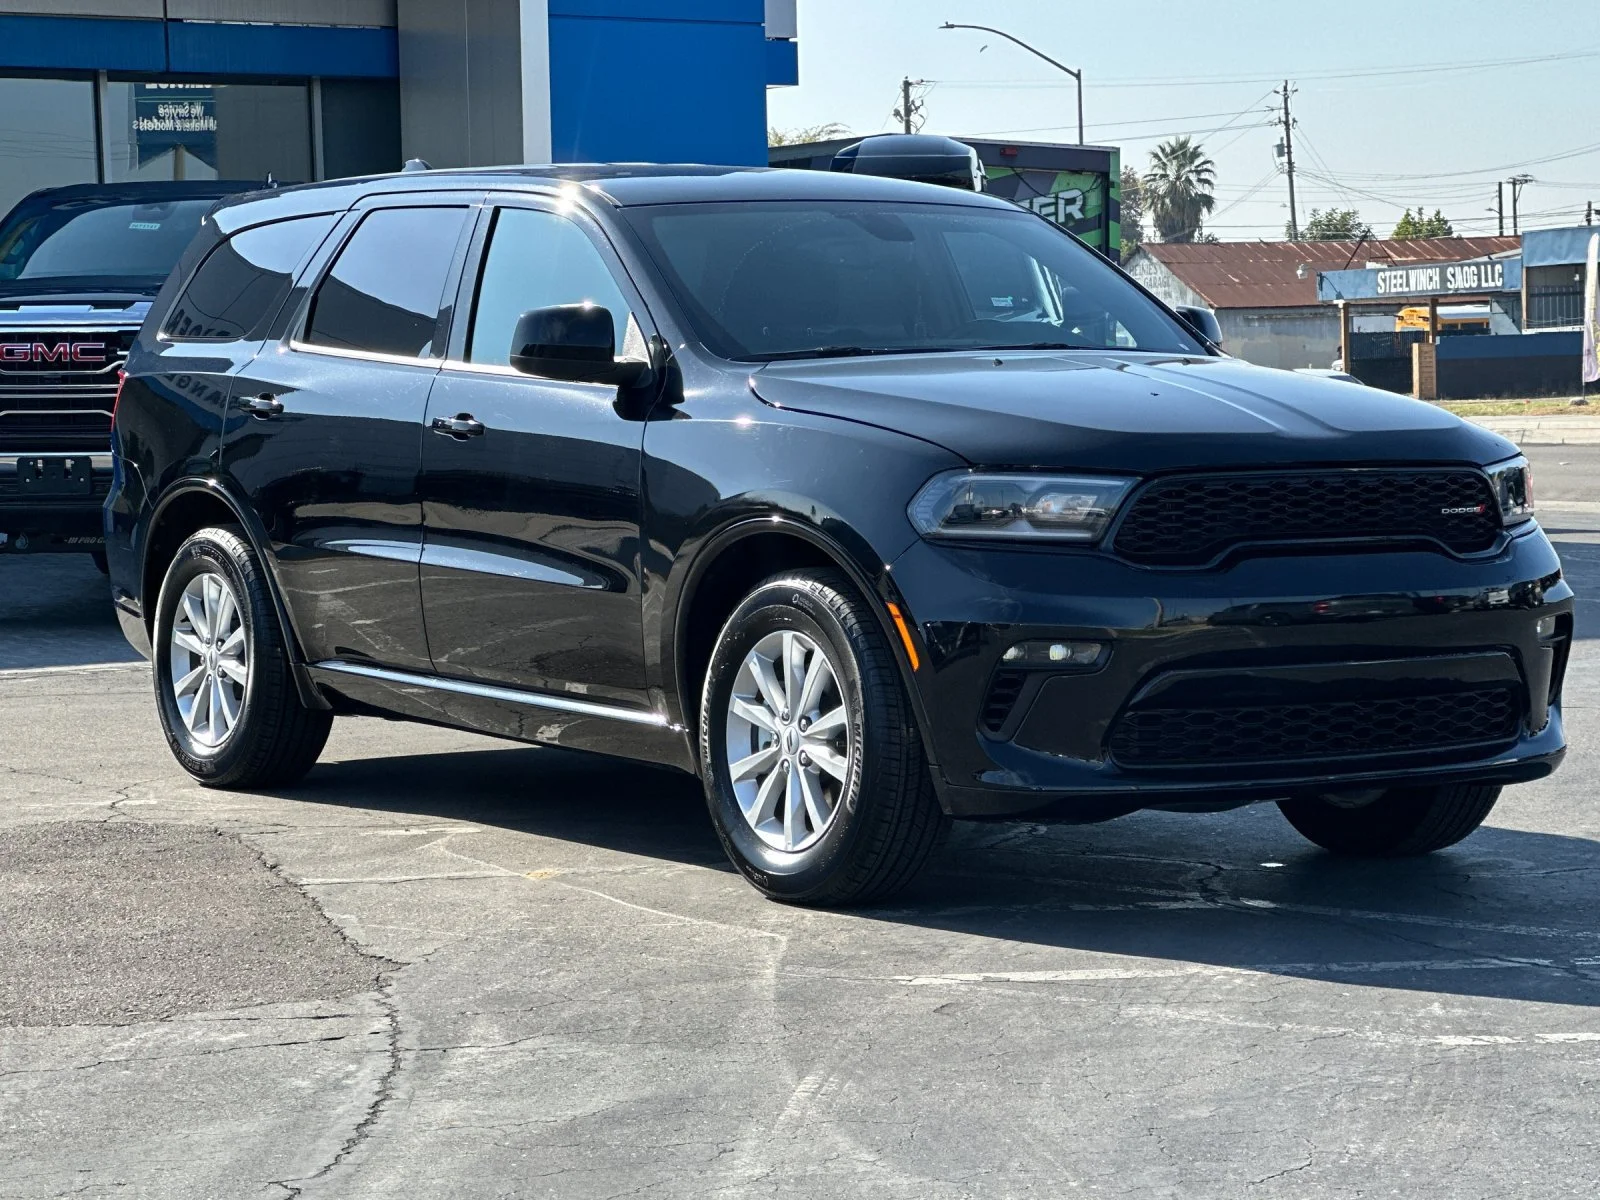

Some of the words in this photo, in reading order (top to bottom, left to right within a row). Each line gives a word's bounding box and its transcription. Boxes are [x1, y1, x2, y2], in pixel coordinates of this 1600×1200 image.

[1481, 264, 1504, 288] LLC
[0, 342, 106, 362] GMC
[1441, 506, 1482, 514] DODGE
[847, 722, 862, 810] MICHELIN
